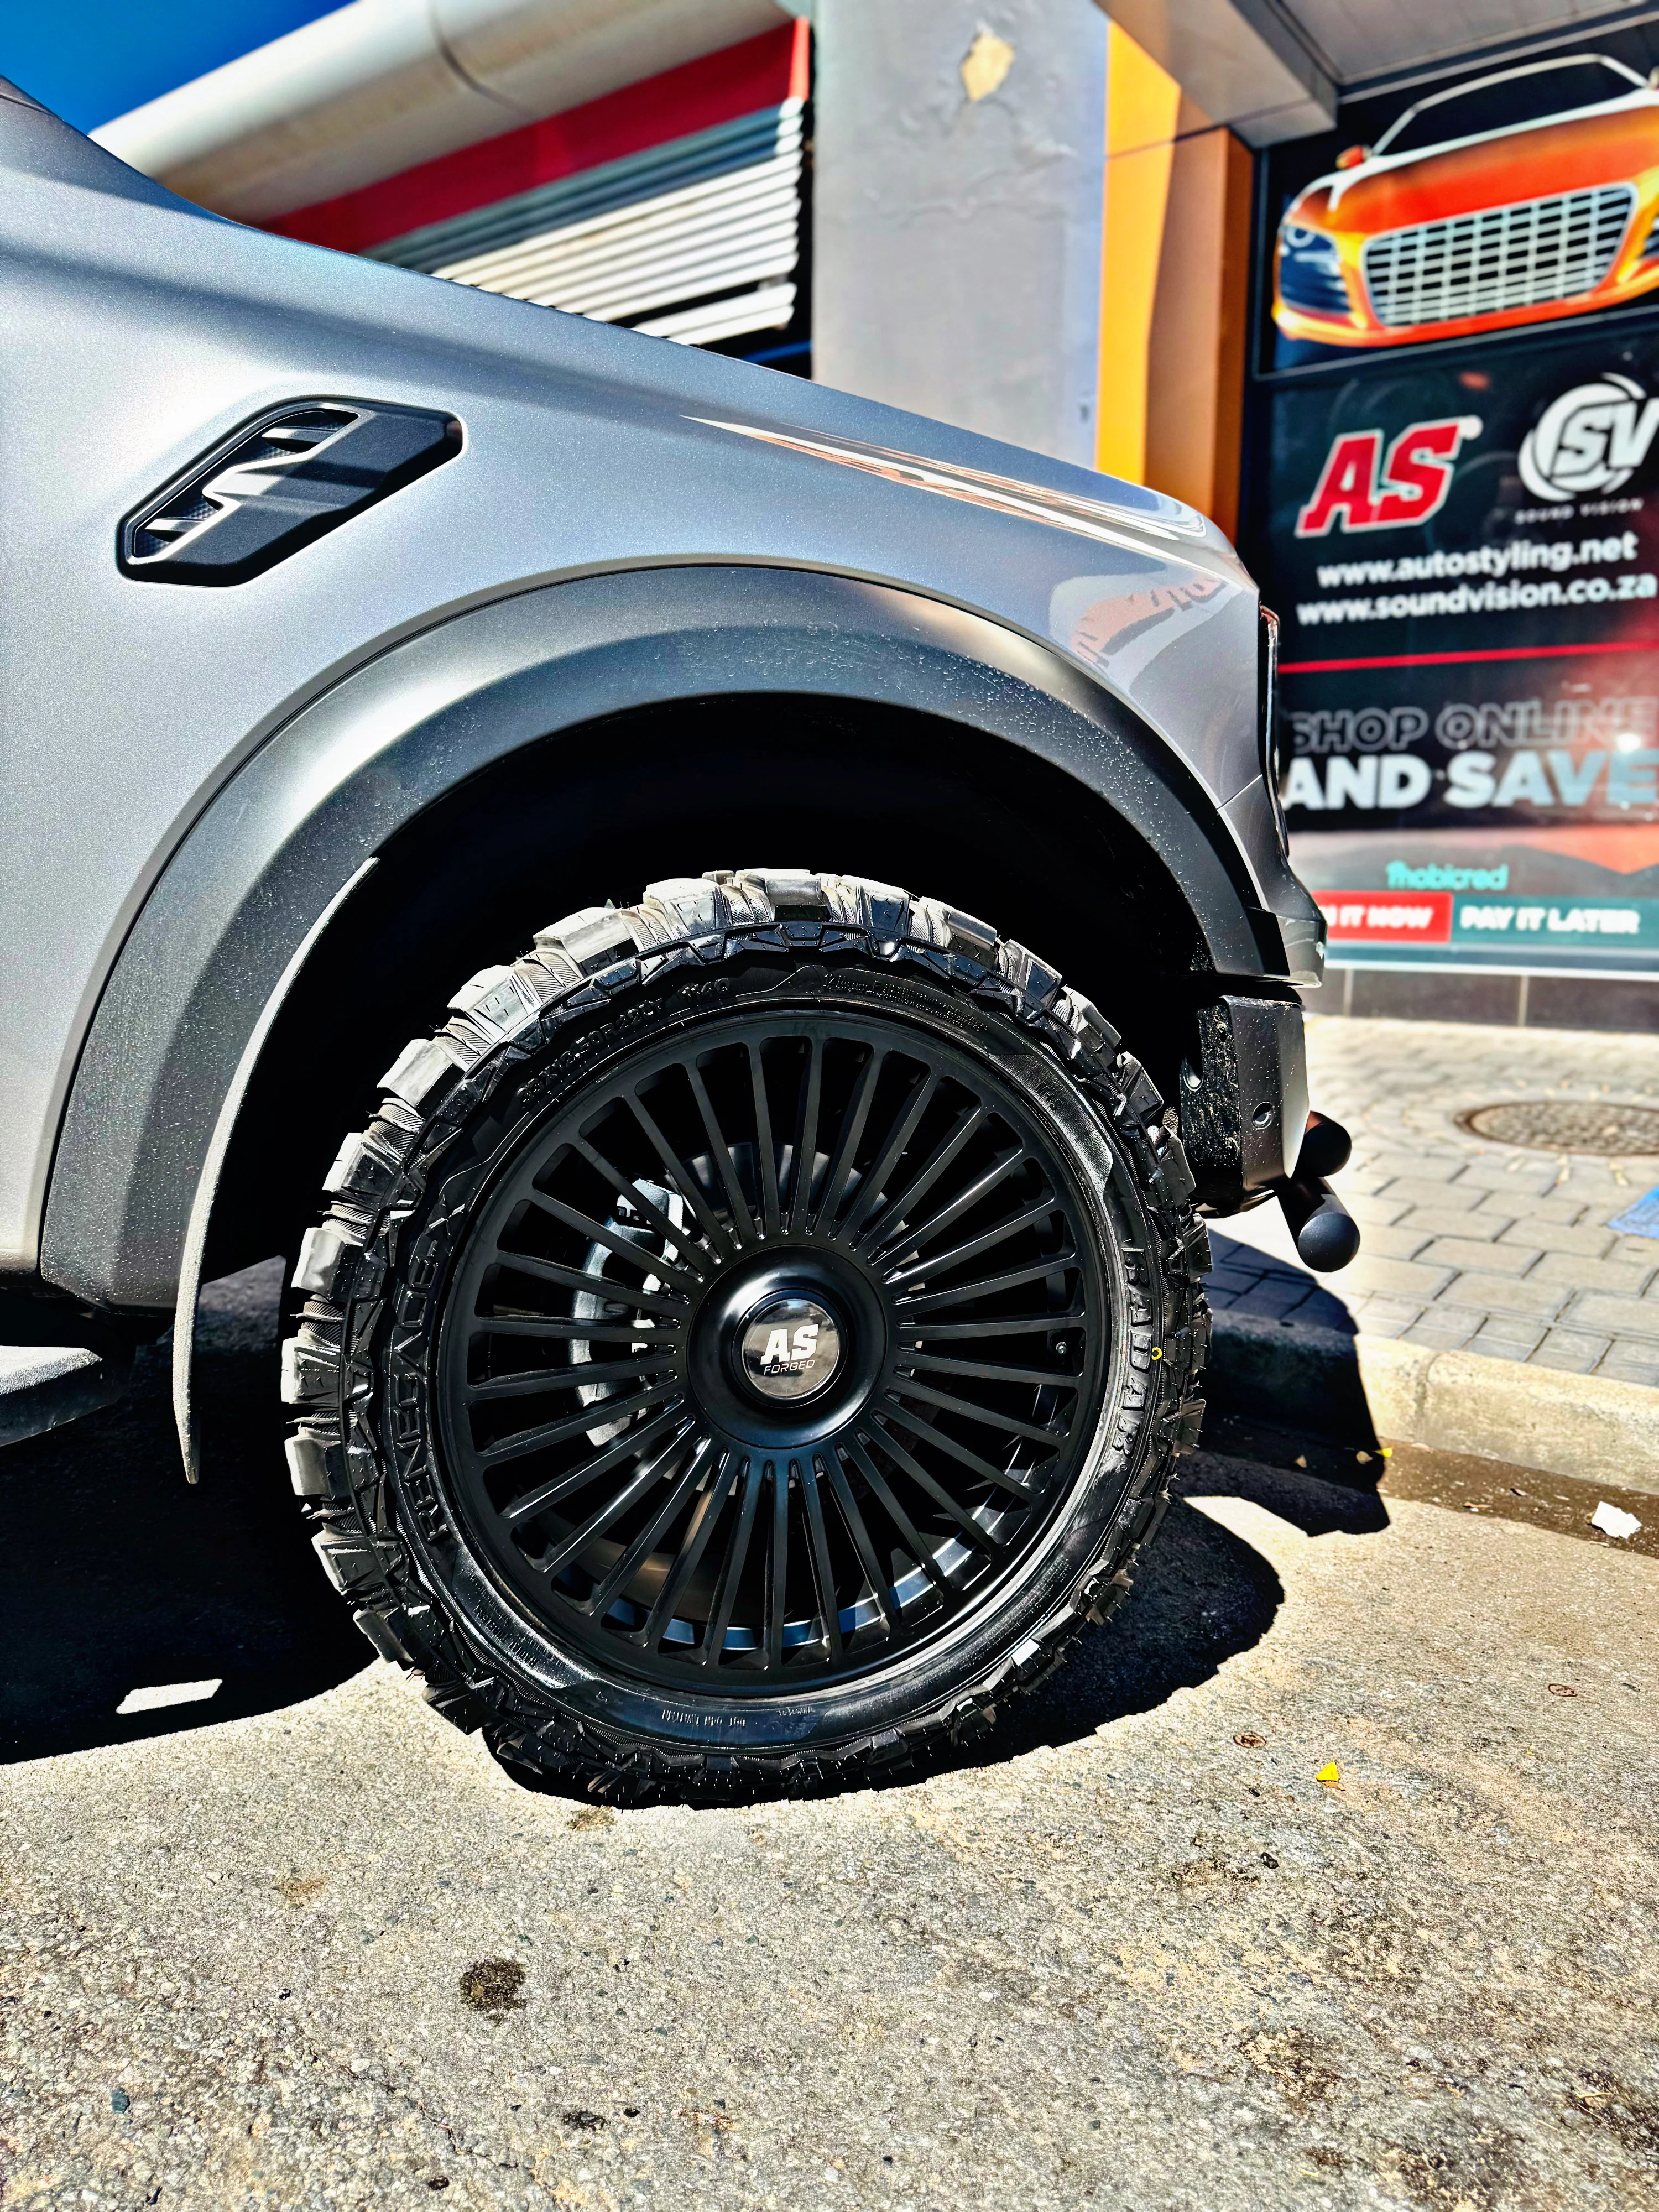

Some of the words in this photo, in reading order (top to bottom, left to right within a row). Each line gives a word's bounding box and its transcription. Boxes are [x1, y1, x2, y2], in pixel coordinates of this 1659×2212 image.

[1295, 418, 1463, 538] AS
[1317, 530, 1639, 588] www.autostyling.net
[1297, 573, 1657, 625] www.soundvision.co.za
[1291, 706, 1429, 754] SHOP
[1434, 696, 1658, 750] ONLINE
[1281, 753, 1432, 810] AND
[1443, 749, 1659, 808] SAVE
[1366, 905, 1434, 930] NOW
[1460, 905, 1514, 931] PAY
[1515, 906, 1546, 931] IT
[1547, 906, 1641, 934] LATER
[760, 1324, 819, 1365] AS
[764, 1359, 815, 1375] FORGED
[1112, 1248, 1152, 1458] RADAR
